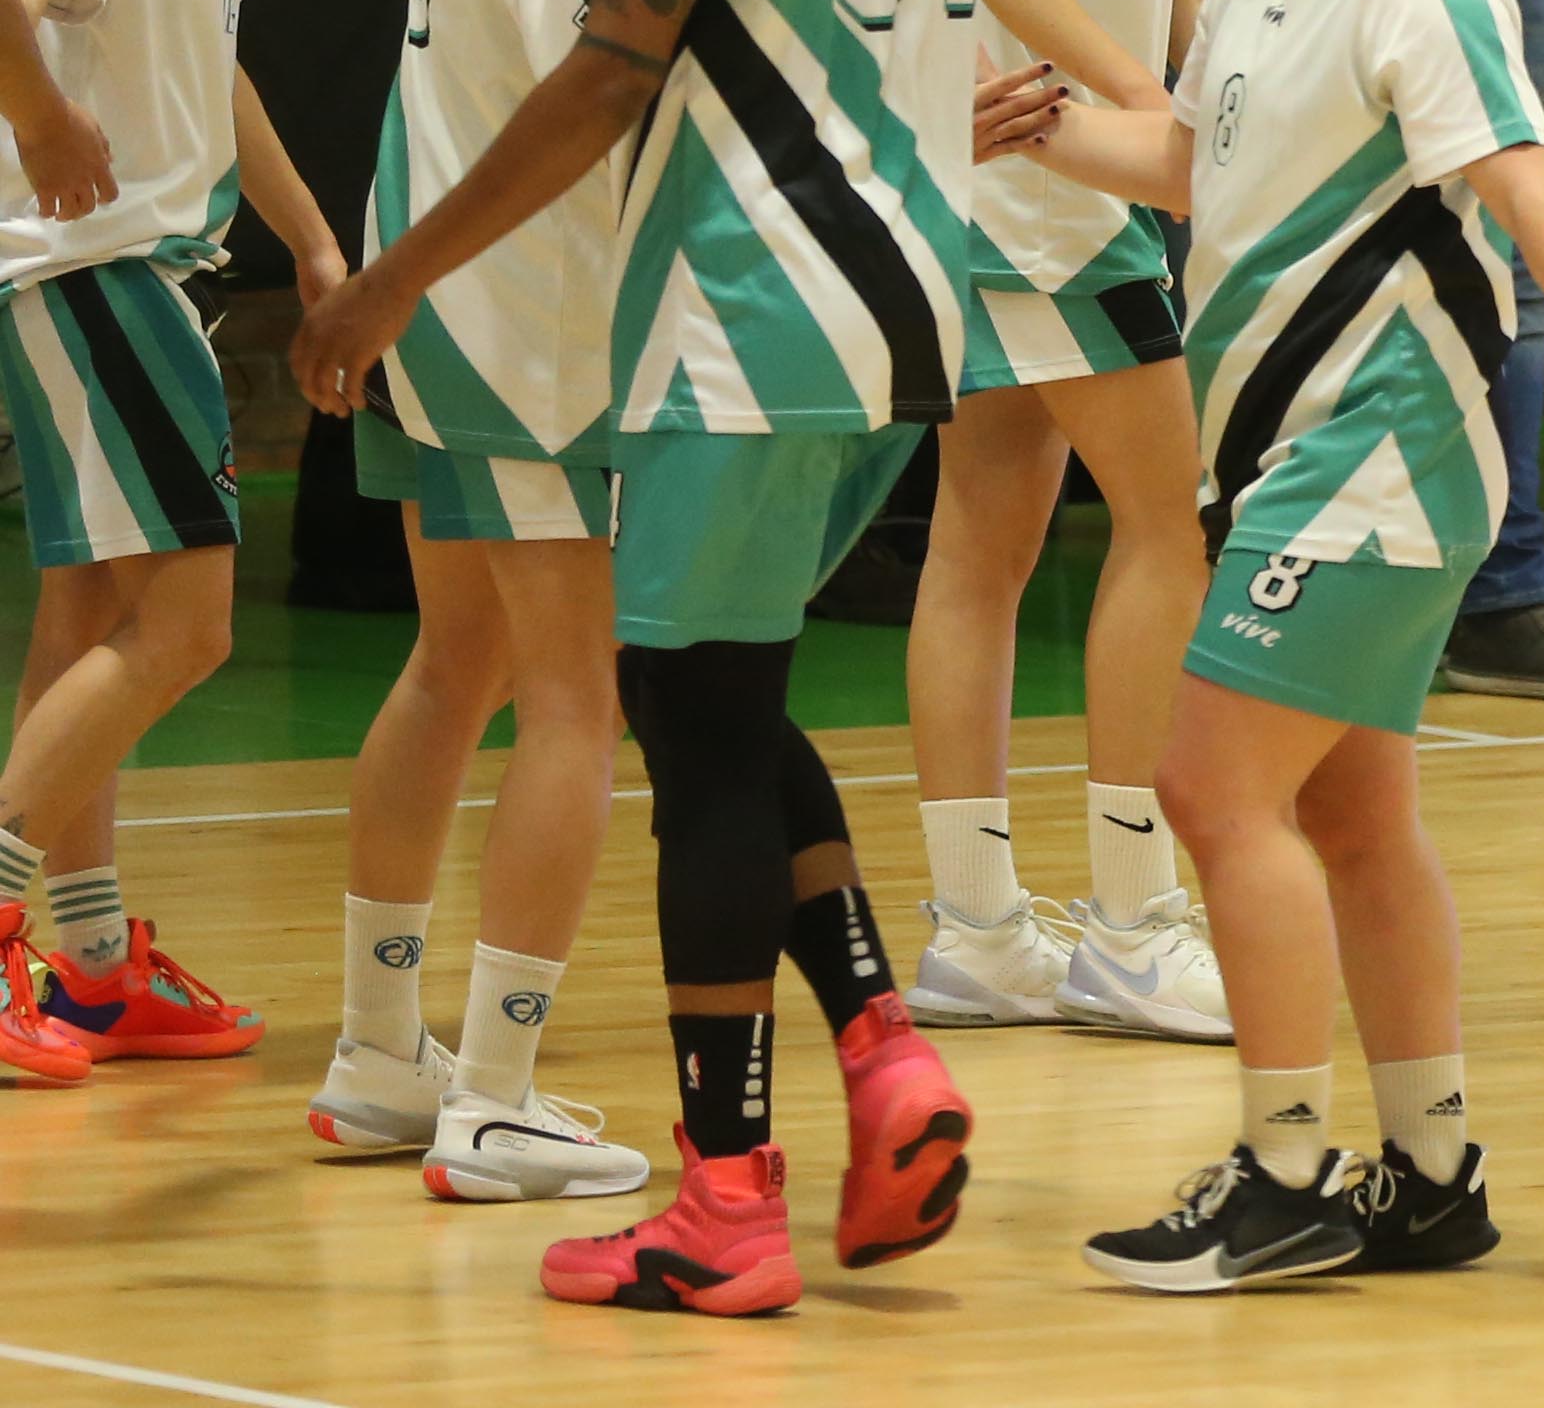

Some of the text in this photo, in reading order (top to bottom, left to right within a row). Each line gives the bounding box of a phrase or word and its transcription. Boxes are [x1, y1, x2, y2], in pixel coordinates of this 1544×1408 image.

[1212, 72, 1246, 167] 8
[1247, 552, 1318, 614] 8
[1220, 613, 1282, 648] vive
